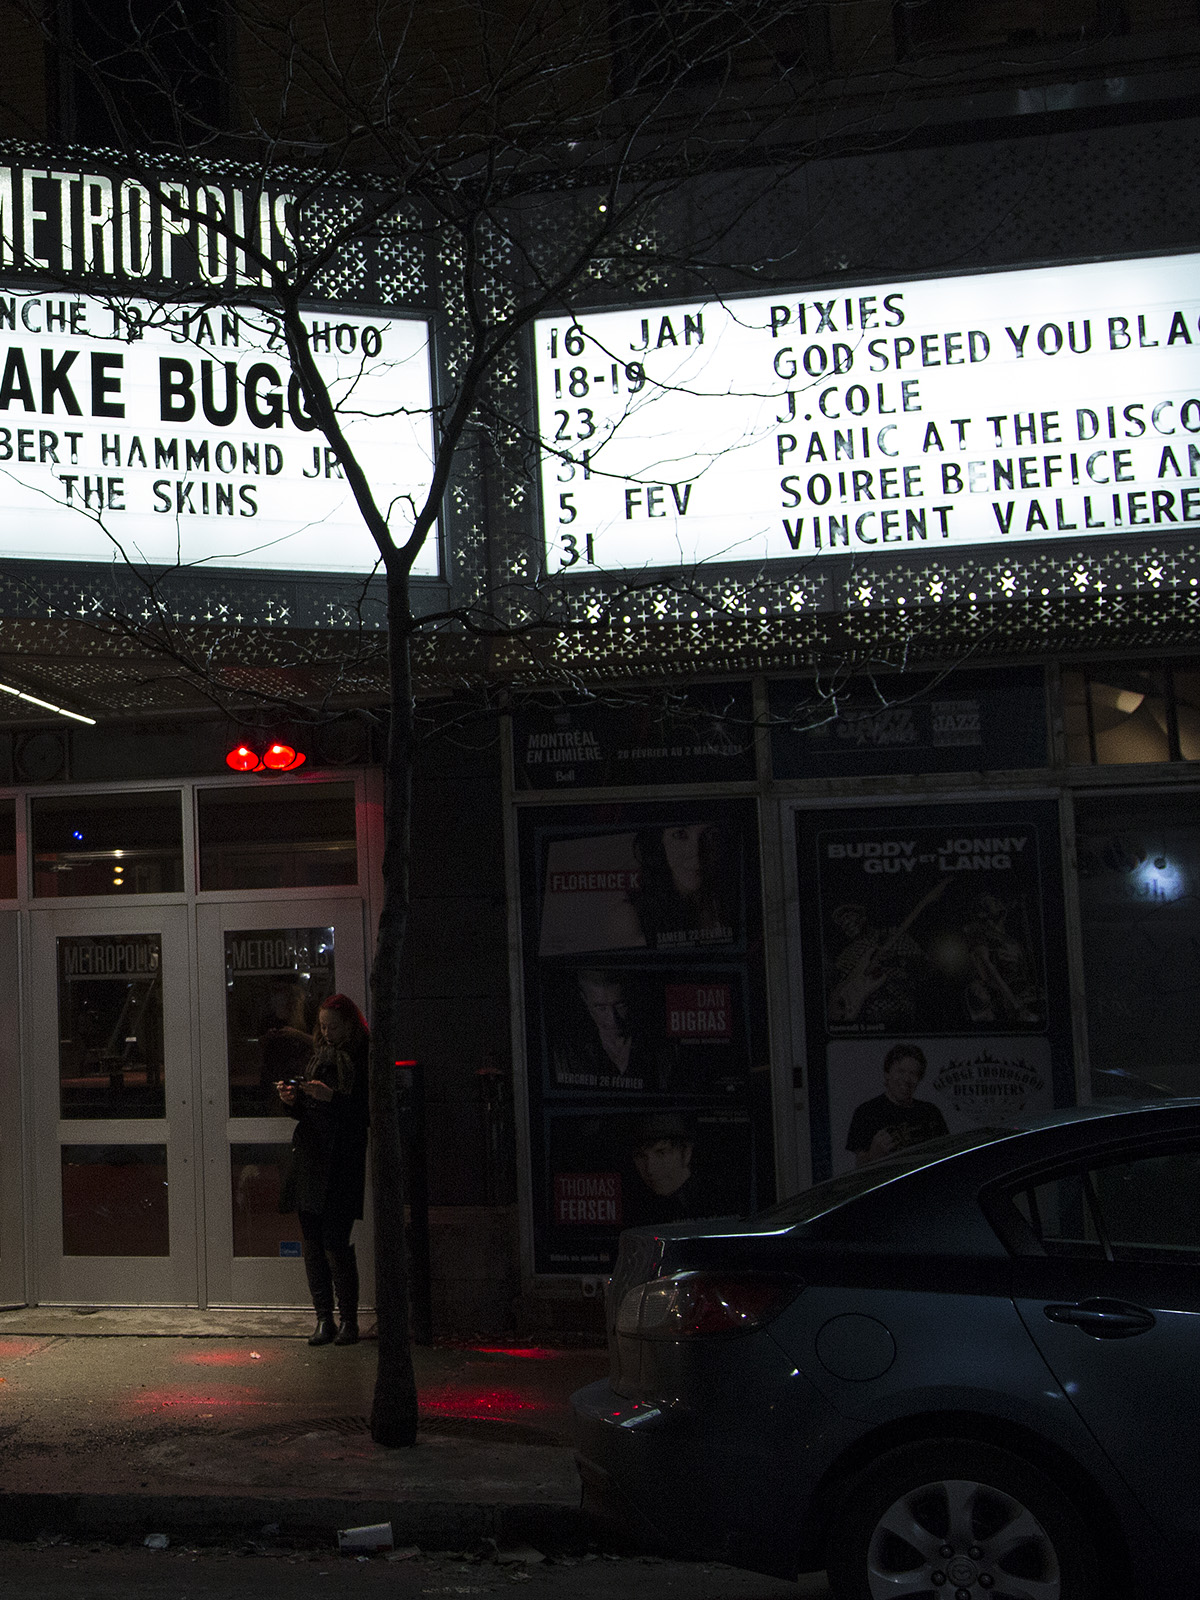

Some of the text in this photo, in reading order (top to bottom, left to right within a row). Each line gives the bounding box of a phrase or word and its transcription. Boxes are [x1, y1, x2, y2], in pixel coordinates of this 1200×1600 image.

[171, 310, 240, 347] JAN
[550, 293, 905, 359] 16 JAN PIXIES
[554, 311, 1200, 399] 18-19 GOD SPEED YOU BLA
[554, 379, 922, 441] 23 J.COLE
[556, 398, 1200, 482] 31 PANIC AT THE DISCO
[101, 433, 284, 476] HAMMOND
[303, 446, 345, 479] JR
[780, 464, 933, 508] SOIREE
[940, 449, 1135, 494] BENEFICE
[59, 474, 258, 518] THE SKINS
[559, 483, 692, 524] 5 FEV
[560, 487, 1200, 566] 31 VINCENT VALLIERE
[527, 730, 599, 749] MONTRÉAL
[526, 750, 544, 764] EN
[827, 837, 1027, 859] BUDDY JONNY
[863, 857, 917, 874] GUY
[939, 854, 1012, 872] LANG
[553, 871, 640, 891] FLORENCE K
[64, 944, 158, 973] METROPOLIS
[232, 939, 329, 970] METROPLIS
[697, 988, 725, 1007] DAN
[670, 1010, 726, 1032] BIGRAS
[560, 1178, 616, 1198] THOMAS
[560, 1199, 616, 1220] FERSEN
